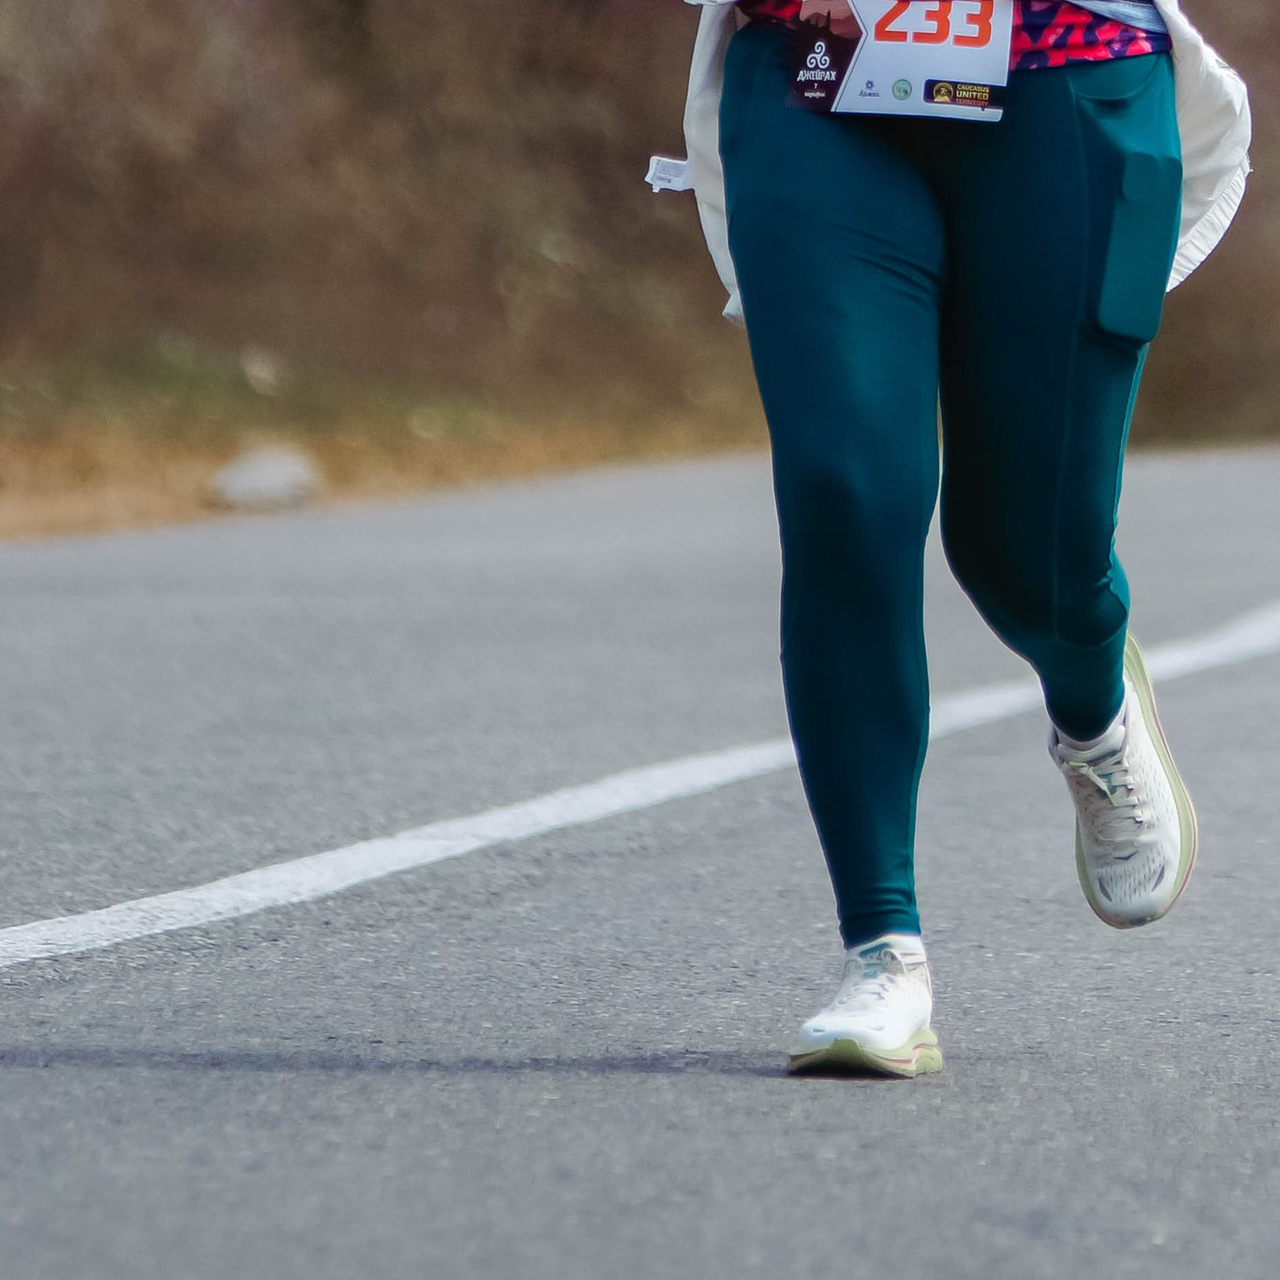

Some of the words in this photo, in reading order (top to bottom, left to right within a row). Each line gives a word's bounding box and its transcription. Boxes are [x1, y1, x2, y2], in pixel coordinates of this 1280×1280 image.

[874, 0, 994, 48] 233
[957, 84, 990, 92] CAUCASUS
[956, 90, 989, 100] UNITED
